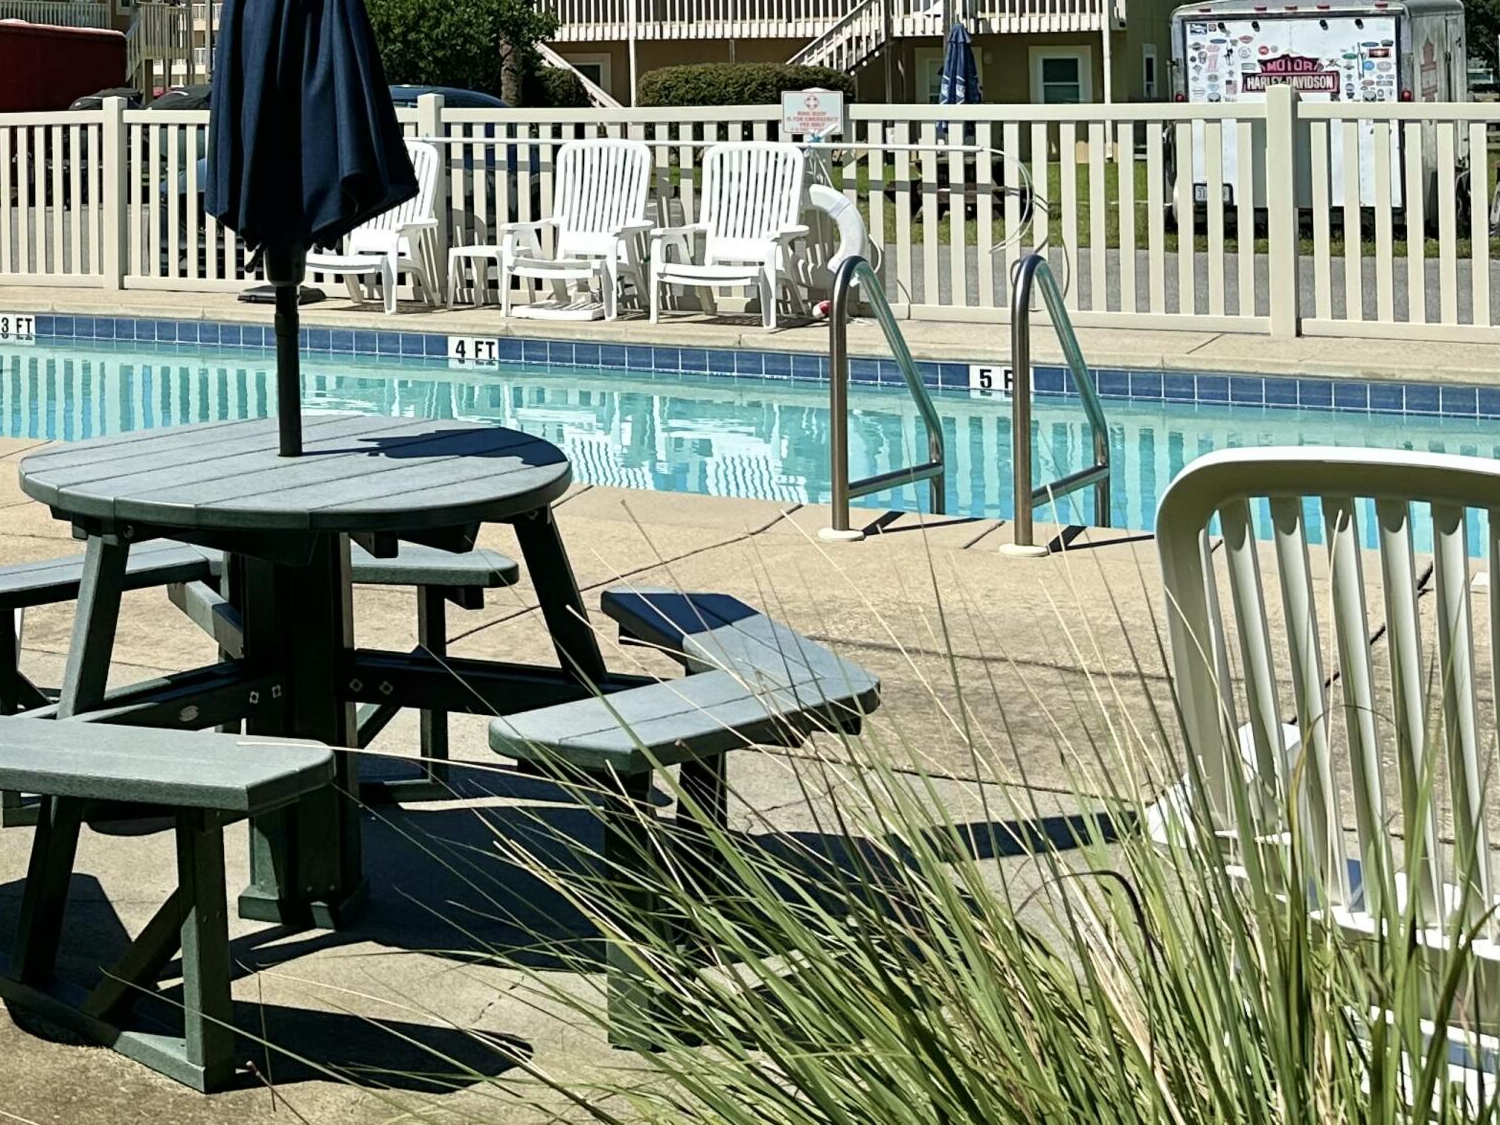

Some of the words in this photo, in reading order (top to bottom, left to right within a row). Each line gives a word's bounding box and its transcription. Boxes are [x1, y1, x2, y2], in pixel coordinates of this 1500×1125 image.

[1267, 59, 1313, 71] MOTOR
[1247, 76, 1334, 89] HARLEY-DAVIDSON
[1, 317, 9, 333] 3
[16, 318, 33, 334] FT
[455, 340, 466, 357] 4
[475, 341, 496, 359] FT
[979, 369, 992, 388] 5
[1004, 370, 1013, 389] F
